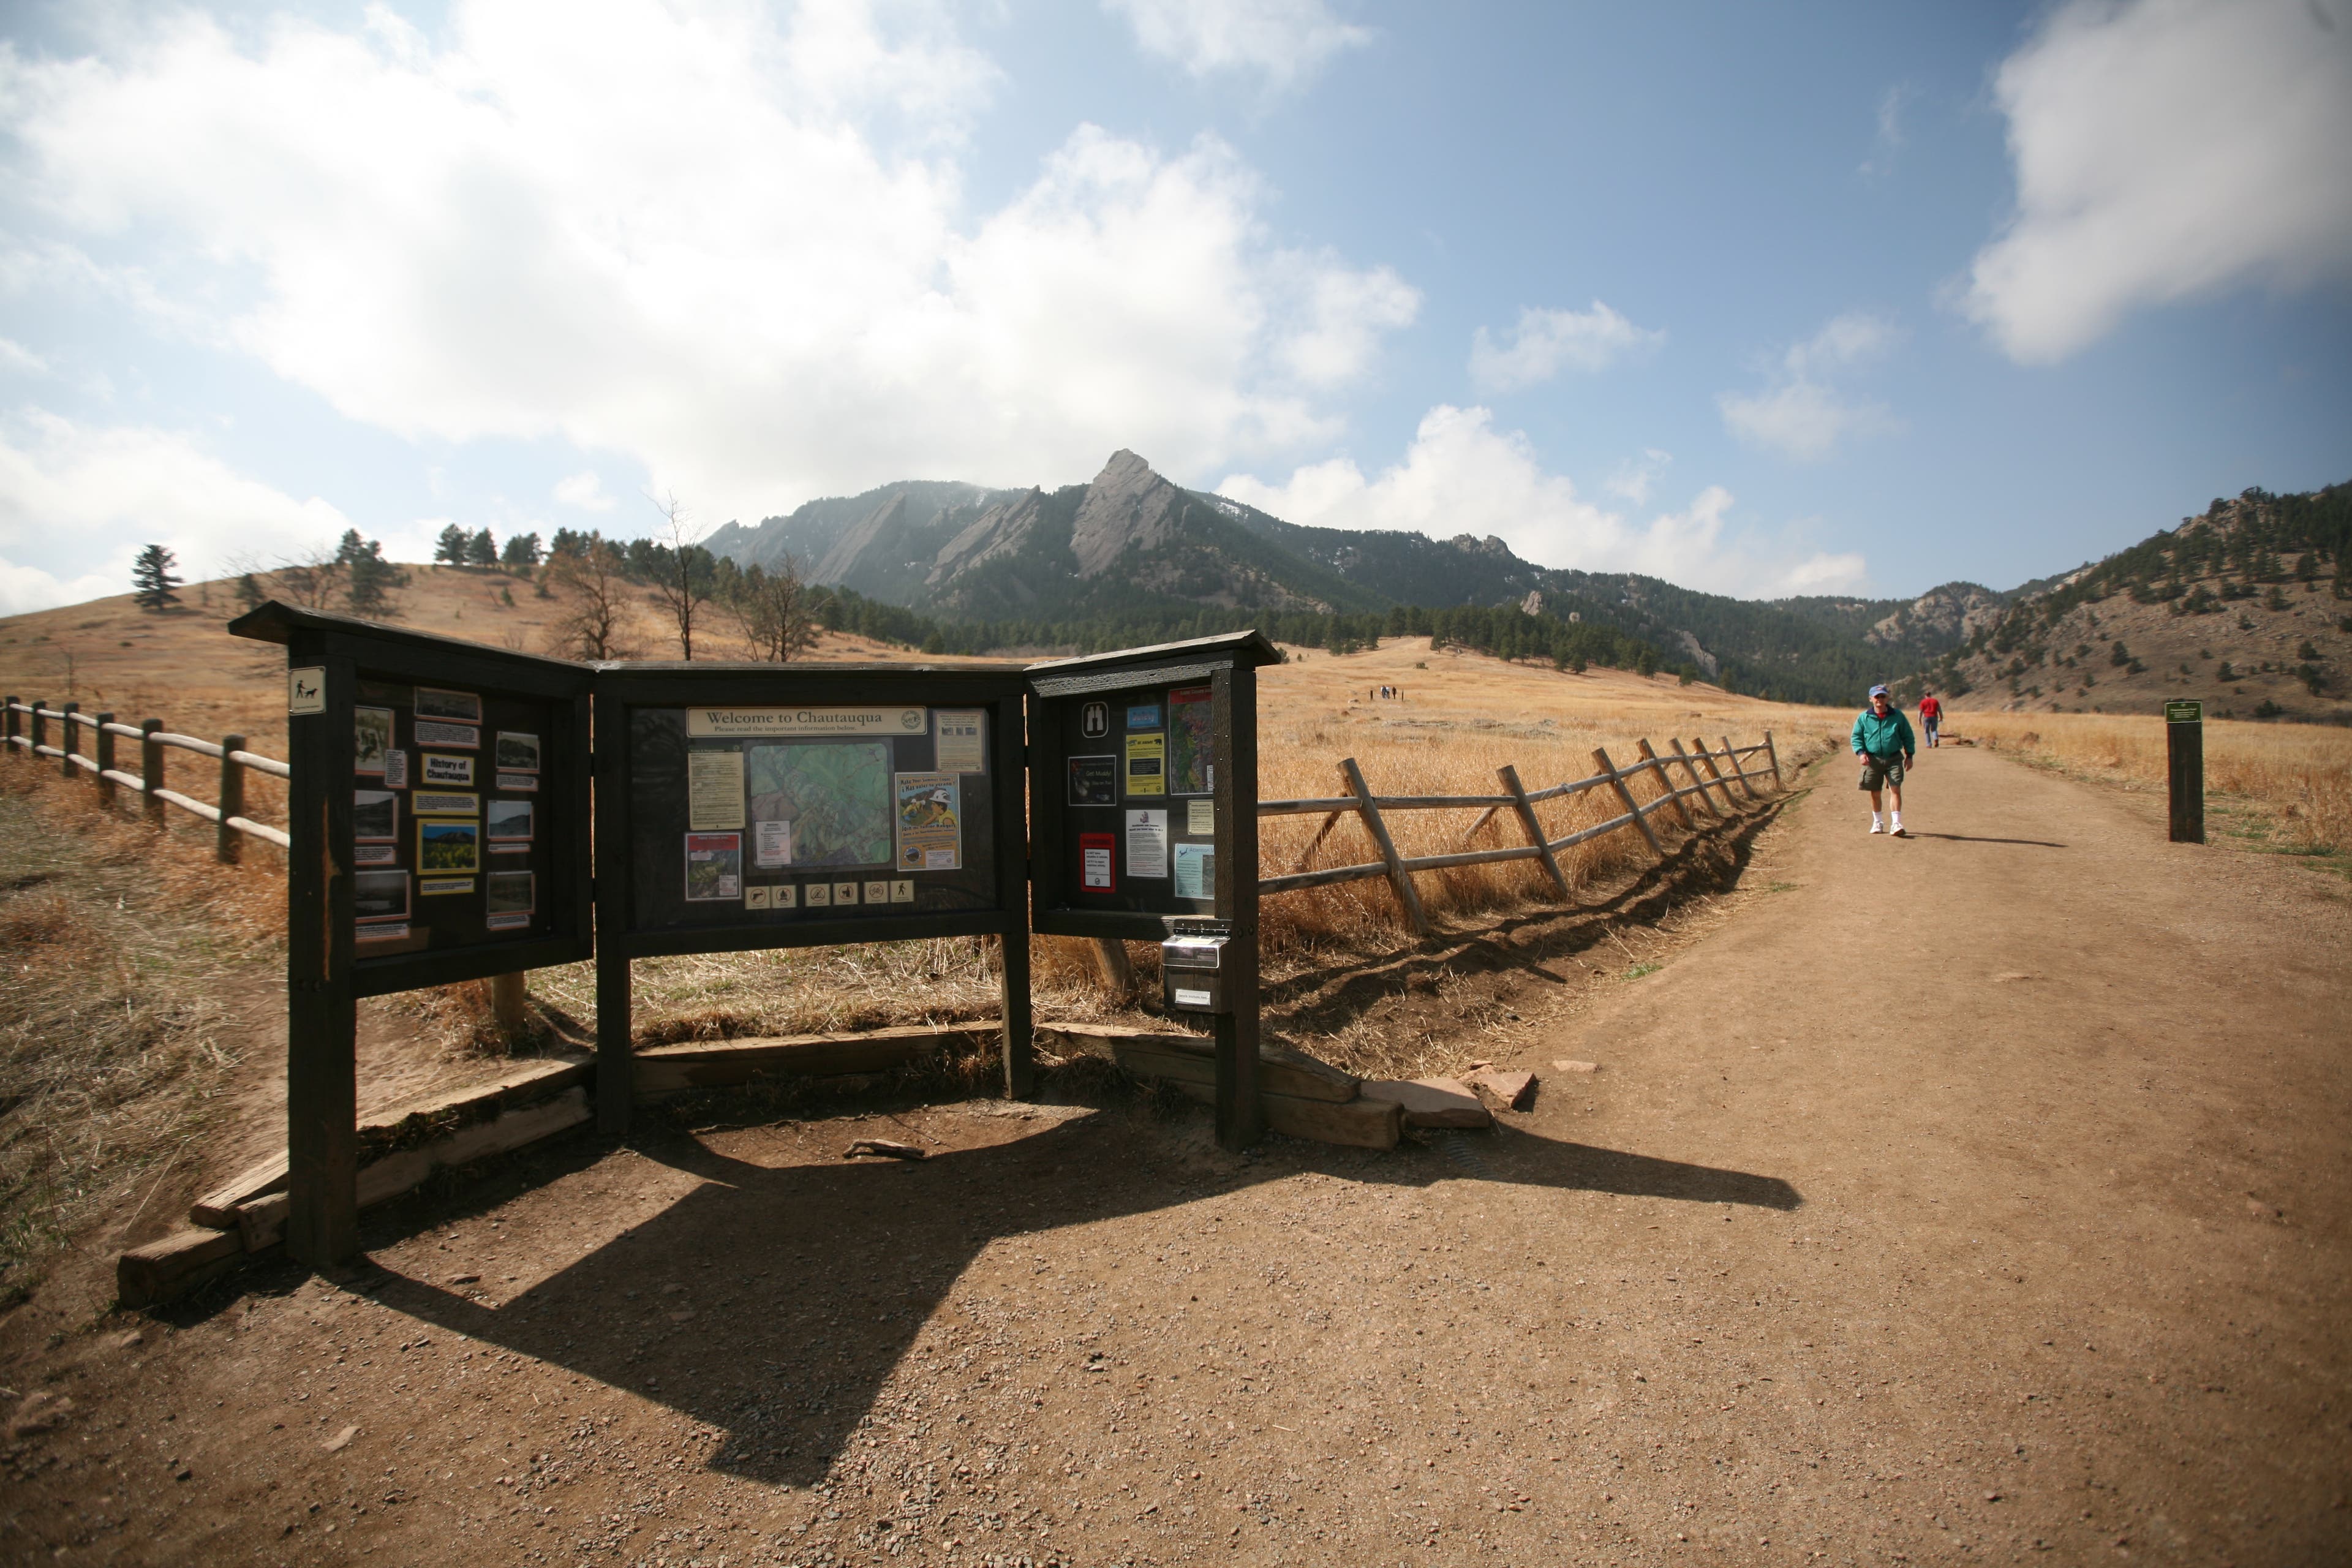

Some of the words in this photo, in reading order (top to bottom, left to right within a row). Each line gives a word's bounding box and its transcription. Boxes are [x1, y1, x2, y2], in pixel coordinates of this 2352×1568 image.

[706, 712, 773, 723] Welcome
[779, 714, 791, 723] to
[797, 711, 882, 726] Chautauqua
[431, 758, 457, 771] History
[459, 761, 467, 770] of
[426, 769, 470, 782] Chautauqua
